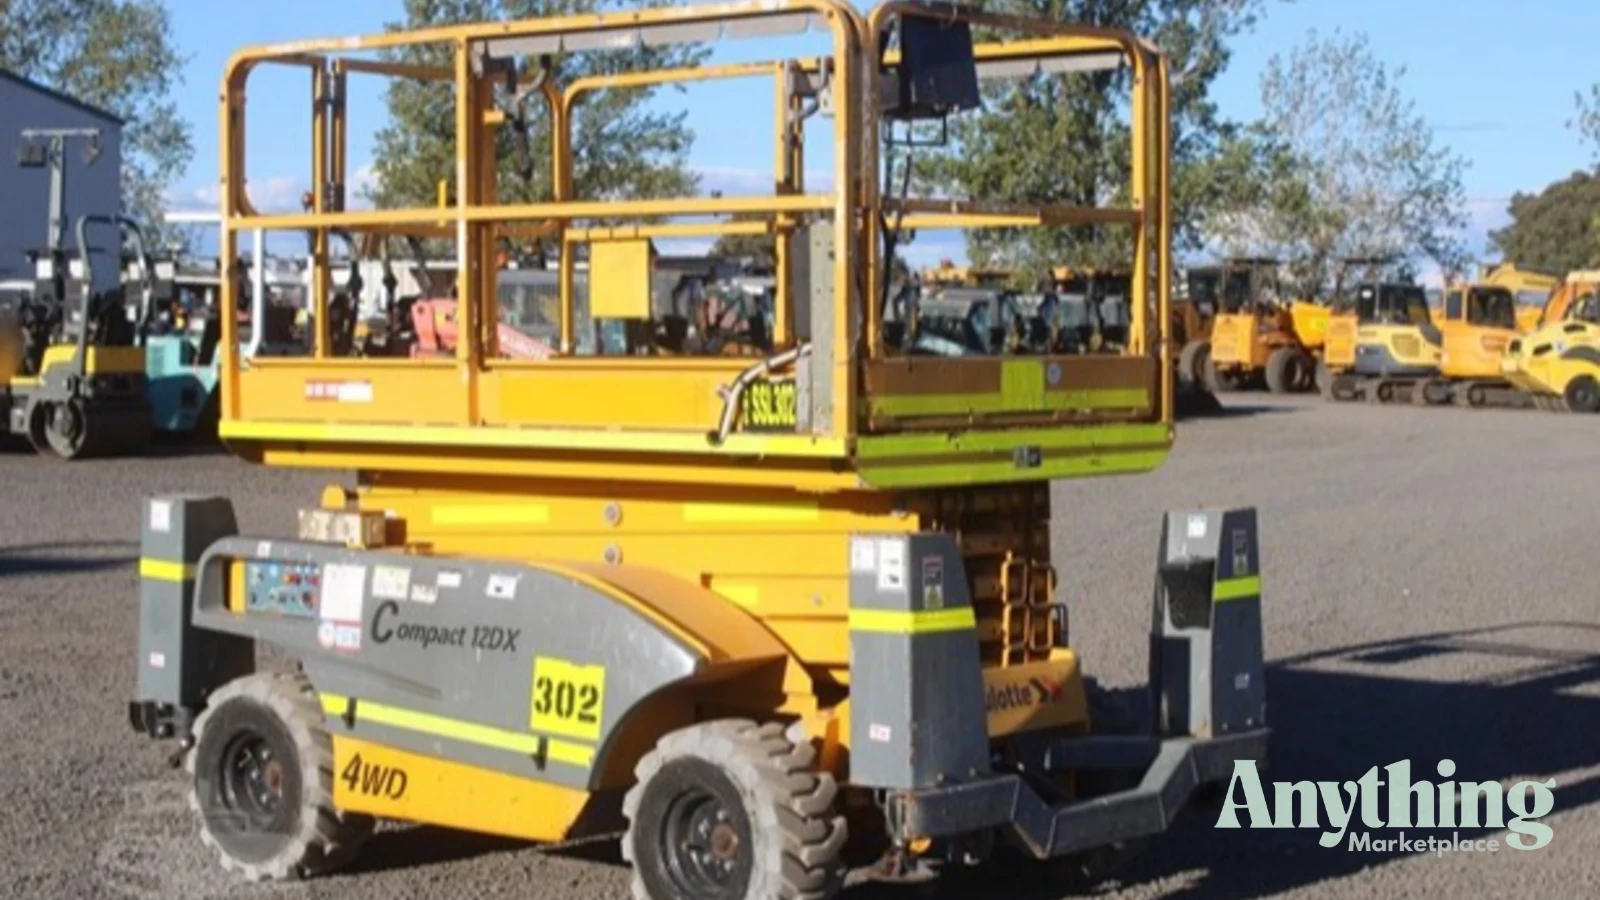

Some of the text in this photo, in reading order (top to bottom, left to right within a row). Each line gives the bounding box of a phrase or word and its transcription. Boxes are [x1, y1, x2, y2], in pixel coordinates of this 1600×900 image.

[371, 599, 466, 648] Compact
[471, 624, 520, 651] 12DX
[534, 676, 599, 723] 302
[341, 752, 408, 800] 4WD
